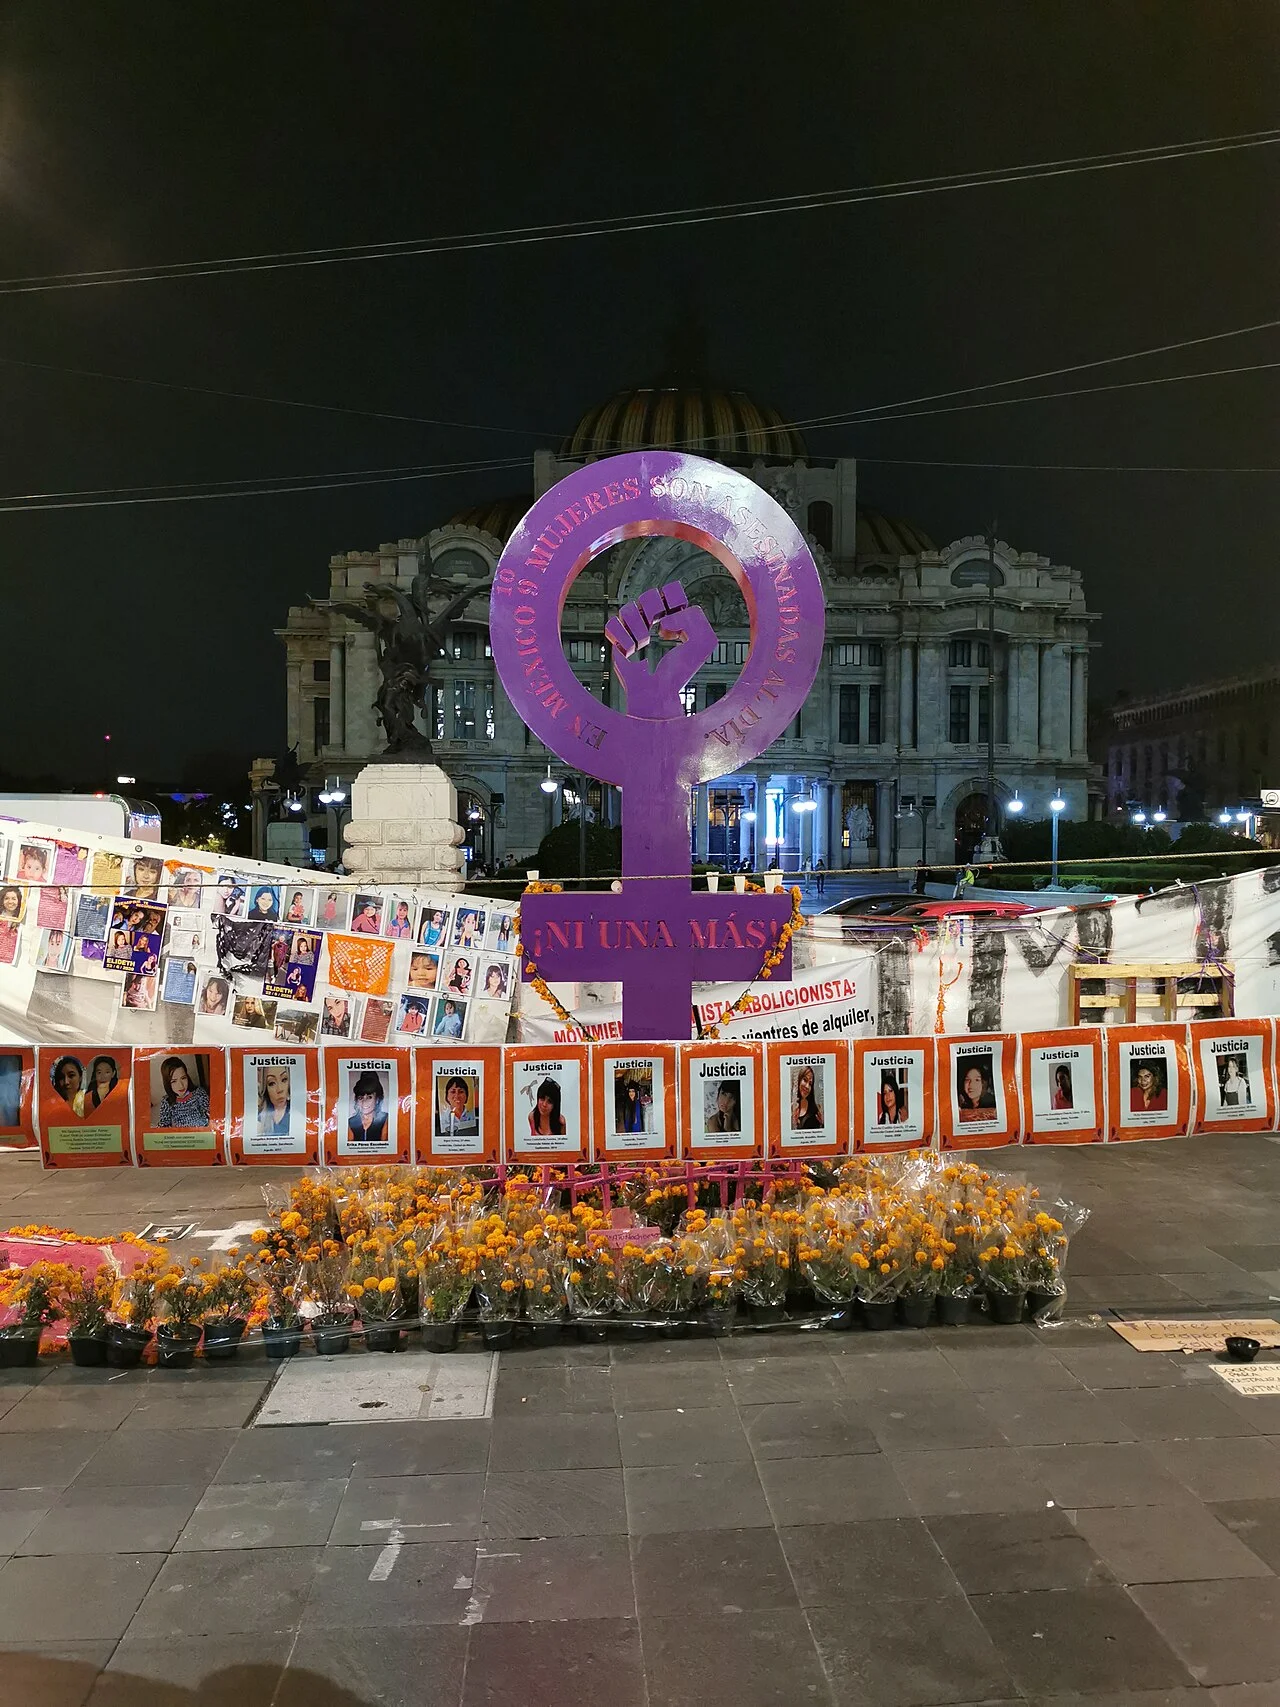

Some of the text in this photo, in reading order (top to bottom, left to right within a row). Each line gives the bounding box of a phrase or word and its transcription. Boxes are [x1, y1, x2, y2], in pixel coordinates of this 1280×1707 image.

[650, 475, 712, 502] SON
[525, 477, 642, 574] MUJERES
[715, 495, 800, 664] ASESINADAS
[513, 605, 569, 719] MÉXICO
[756, 669, 786, 704] AL
[567, 713, 608, 751] EN
[598, 919, 677, 949] UNA
[687, 911, 778, 949] MÁS!
[743, 978, 856, 1014] ABOLICIONISTA:
[802, 1018, 819, 1037] de
[822, 1007, 875, 1033] alquiler,
[956, 1045, 992, 1055] Justicia
[1129, 1044, 1165, 1056] Justicia
[1210, 1040, 1249, 1053] Justicia
[250, 1056, 296, 1066] Justicia
[786, 1056, 826, 1065] Justicia
[871, 1056, 914, 1066] Justicia
[1040, 1050, 1079, 1061] Justicia
[347, 1061, 391, 1070] Justicia
[522, 1063, 562, 1072] Justicia
[613, 1060, 653, 1069] Justicia
[700, 1063, 746, 1078] Justicia
[436, 1067, 476, 1076] Justicia
